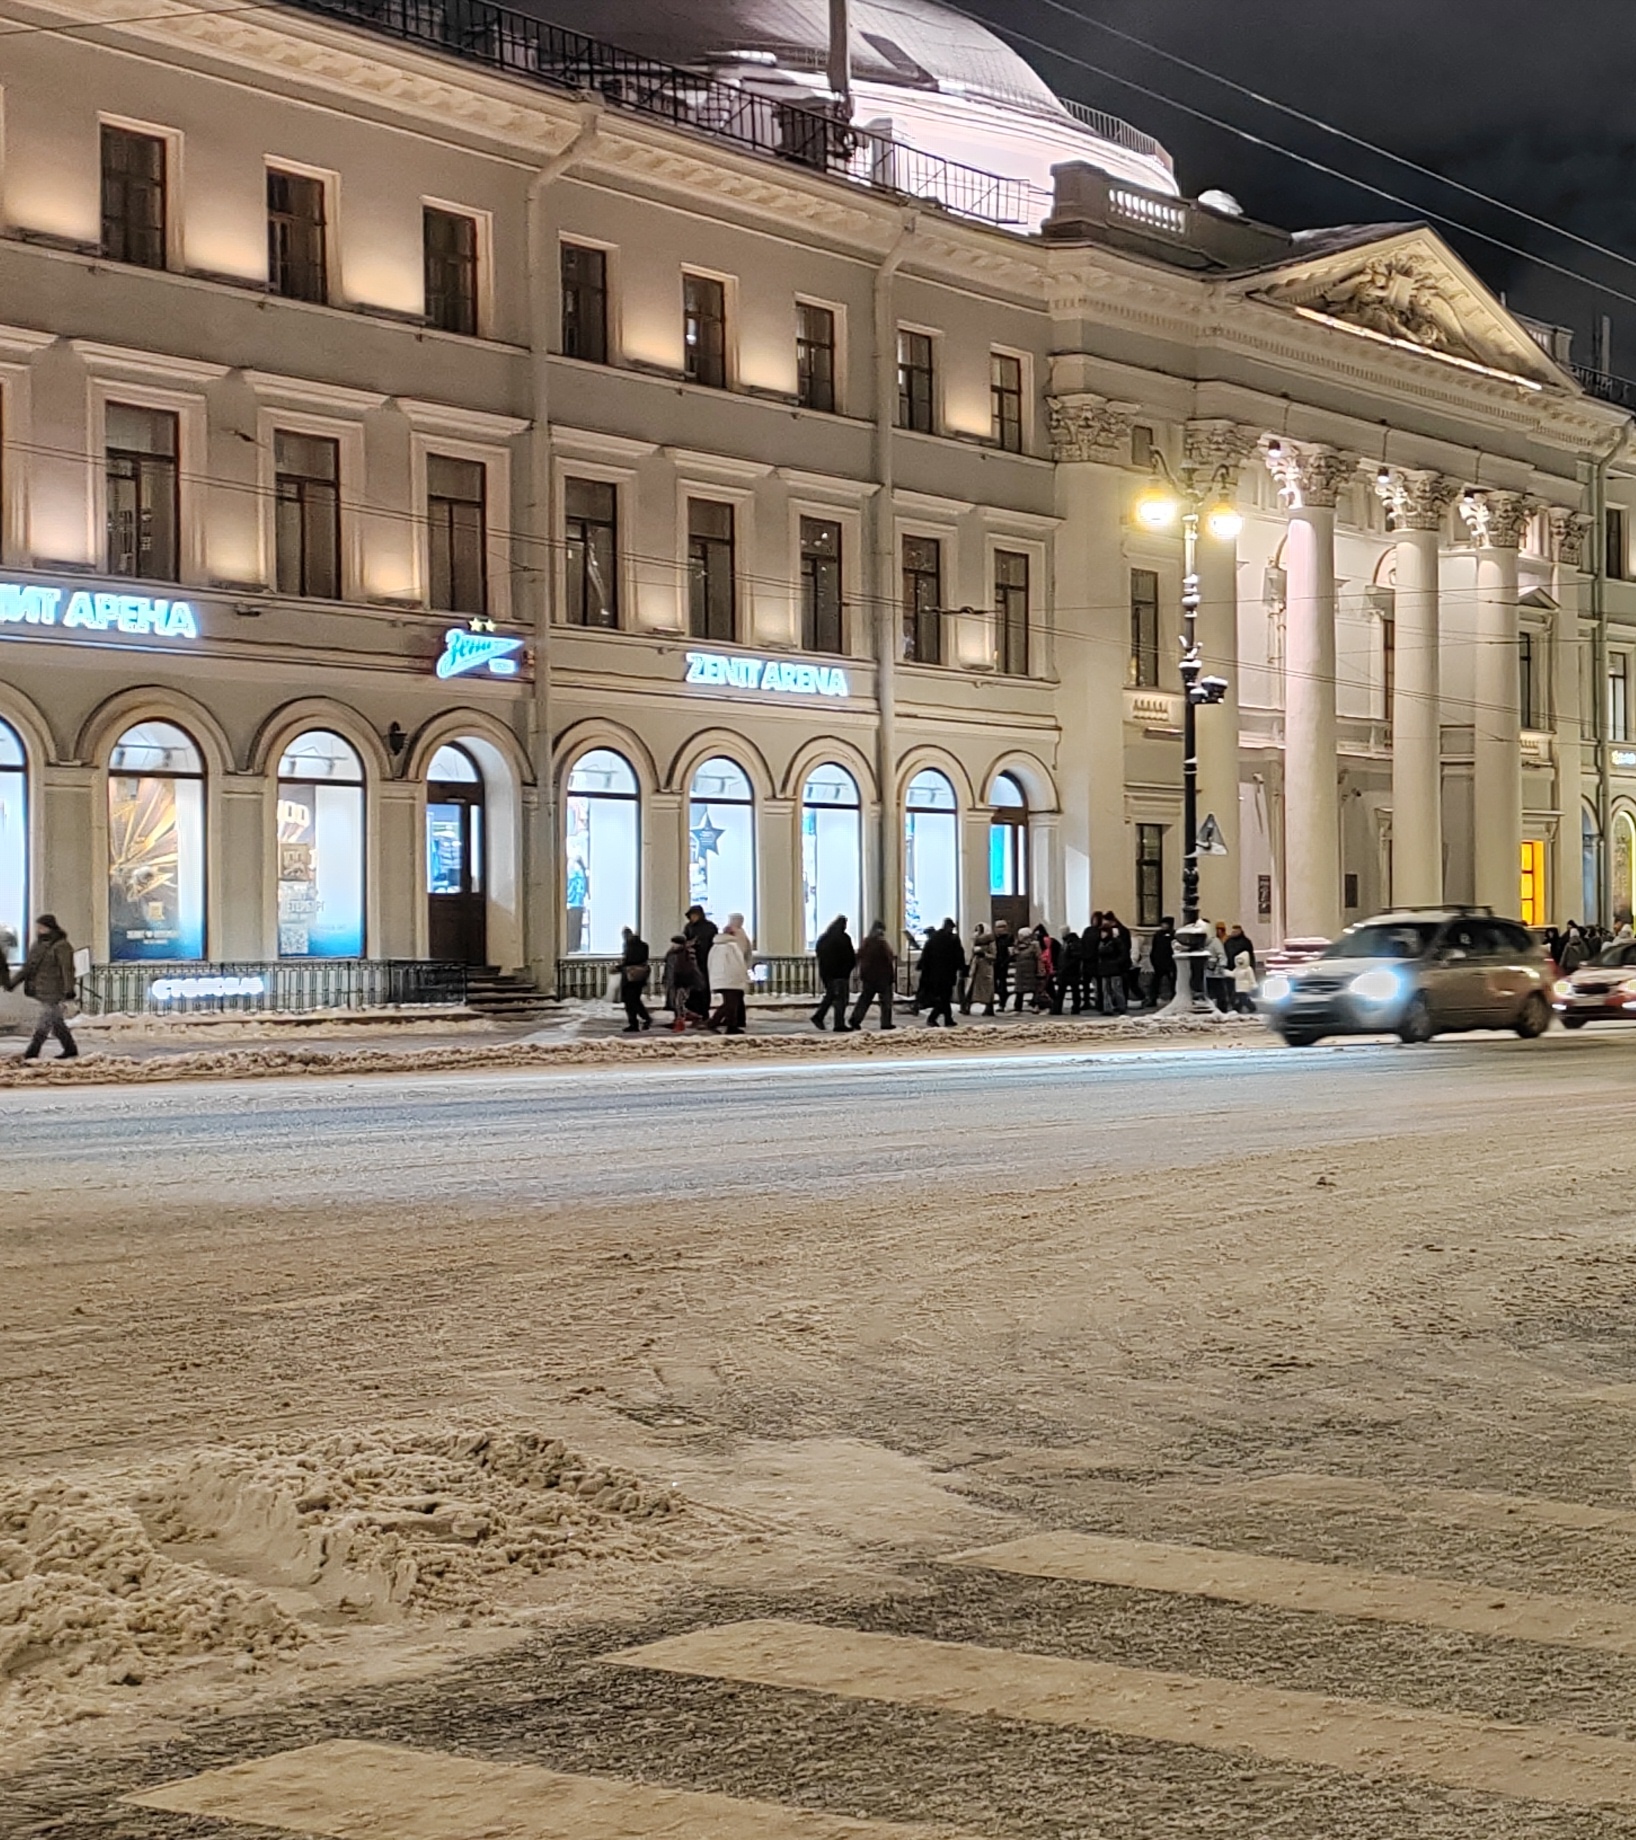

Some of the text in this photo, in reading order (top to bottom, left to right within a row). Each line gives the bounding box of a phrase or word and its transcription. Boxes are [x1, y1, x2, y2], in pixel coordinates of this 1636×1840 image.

[63, 592, 197, 639] АРЕНА
[686, 652, 849, 697] ZENIT ARENA
